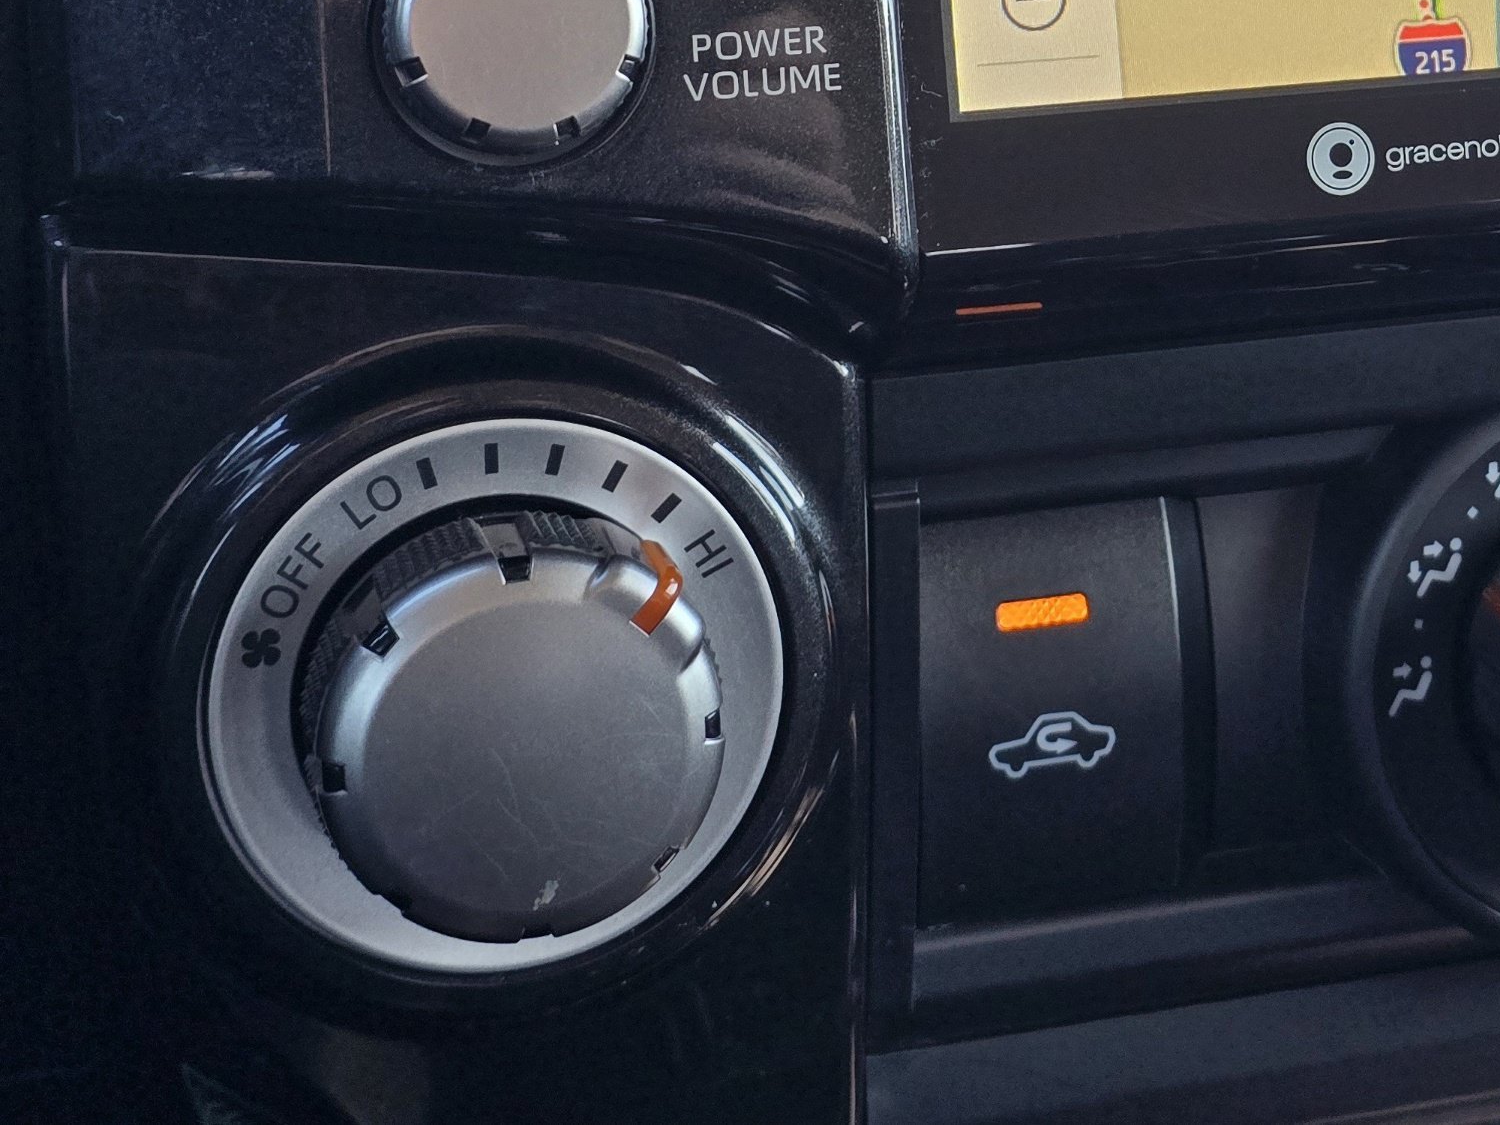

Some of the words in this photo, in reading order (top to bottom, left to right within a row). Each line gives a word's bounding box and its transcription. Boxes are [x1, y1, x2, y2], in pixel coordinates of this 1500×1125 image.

[692, 26, 827, 63] POWER
[1414, 49, 1456, 75] 215
[683, 63, 842, 102] VOLUME
[260, 532, 325, 619] OFF
[340, 475, 402, 531] LO
[684, 529, 735, 579] HI
